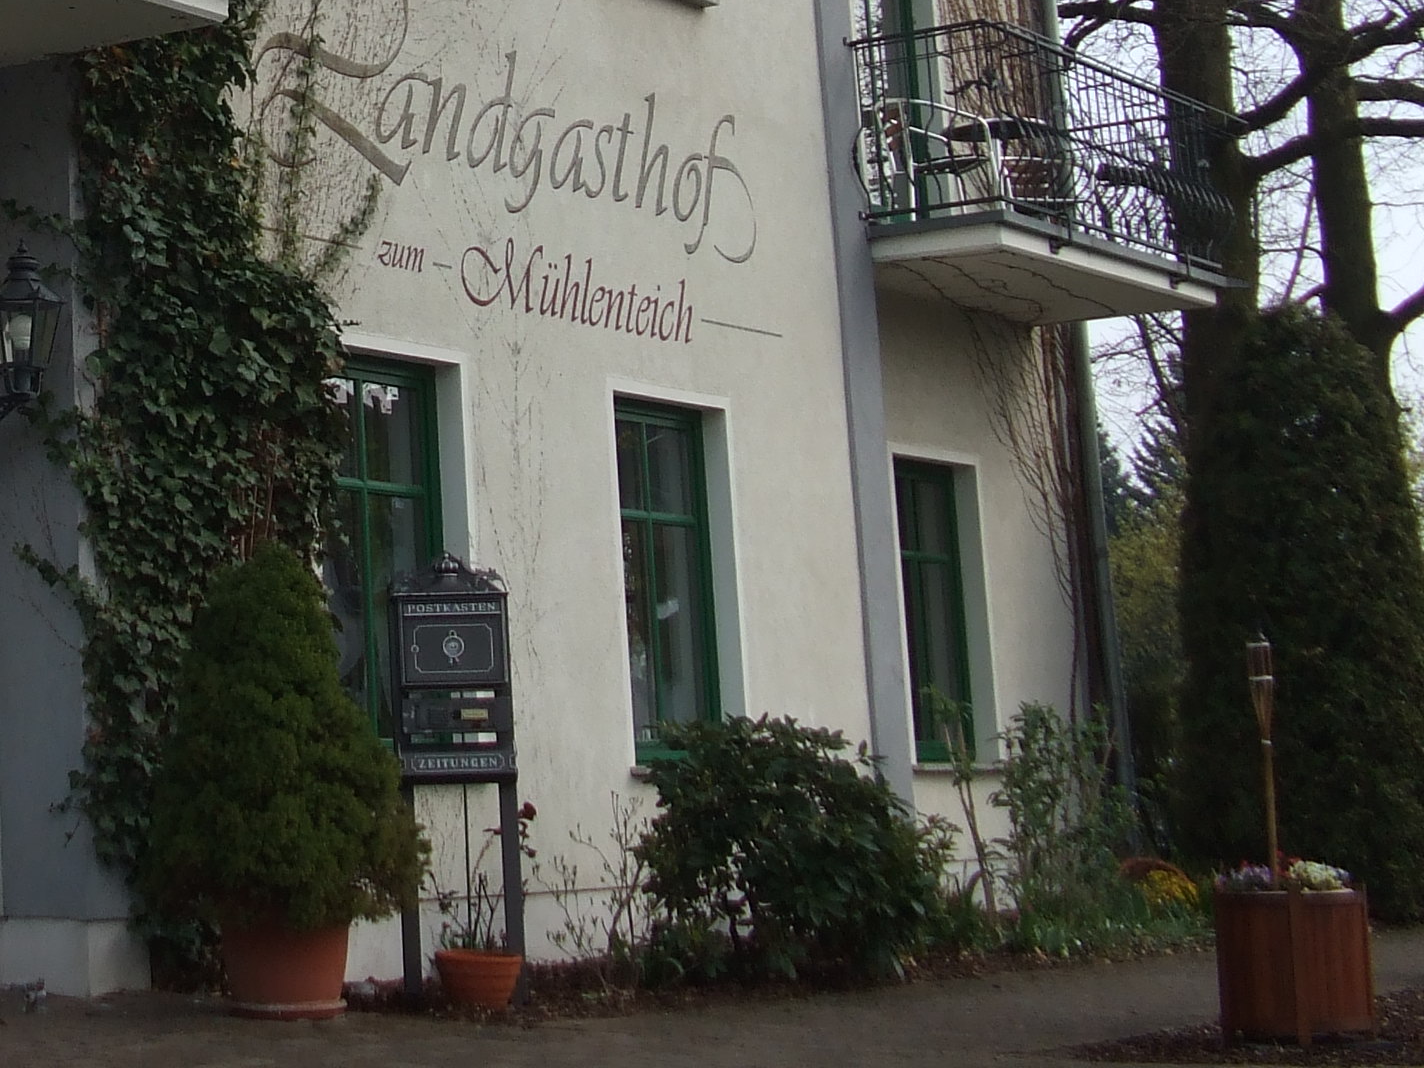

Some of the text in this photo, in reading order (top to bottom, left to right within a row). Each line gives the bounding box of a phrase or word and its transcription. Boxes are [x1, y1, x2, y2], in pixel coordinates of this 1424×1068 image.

[377, 237, 693, 344] zum Mühlenteich
[407, 601, 497, 614] POSTKASTEN
[417, 756, 498, 770] ZEITUNGEN
